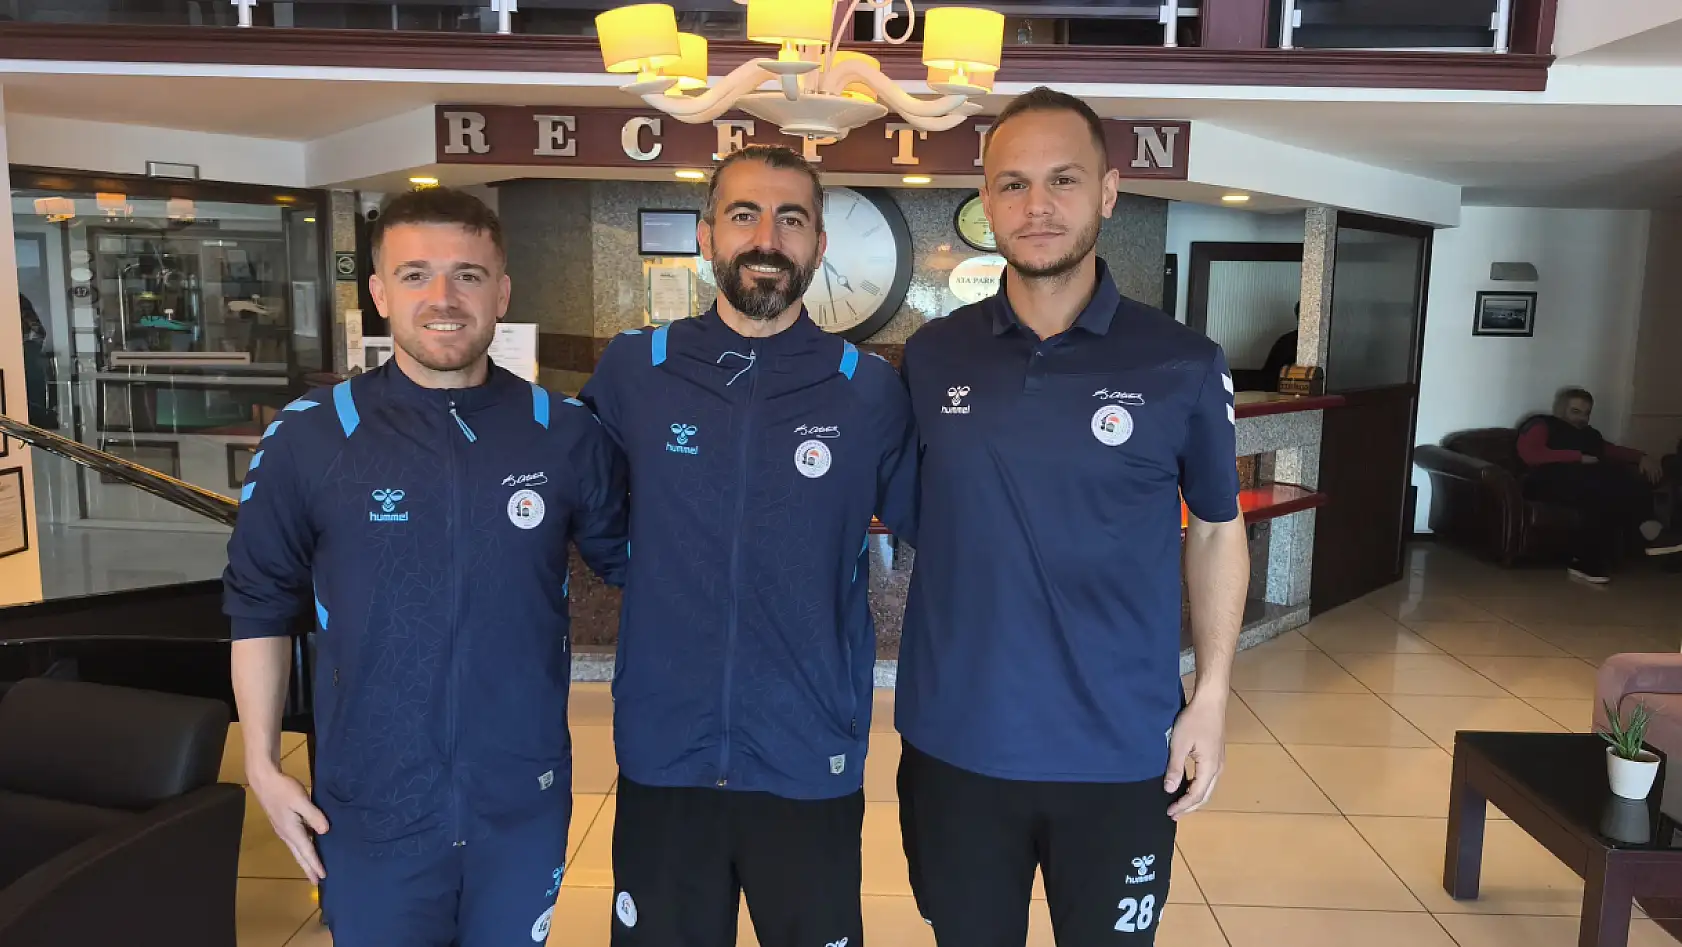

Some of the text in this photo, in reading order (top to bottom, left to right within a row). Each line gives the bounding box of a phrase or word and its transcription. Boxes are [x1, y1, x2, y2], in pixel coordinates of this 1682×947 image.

[444, 111, 1177, 168] RECEPTN
[665, 441, 699, 455] hummel
[369, 511, 409, 522] hummel
[1114, 894, 1156, 933] 28
